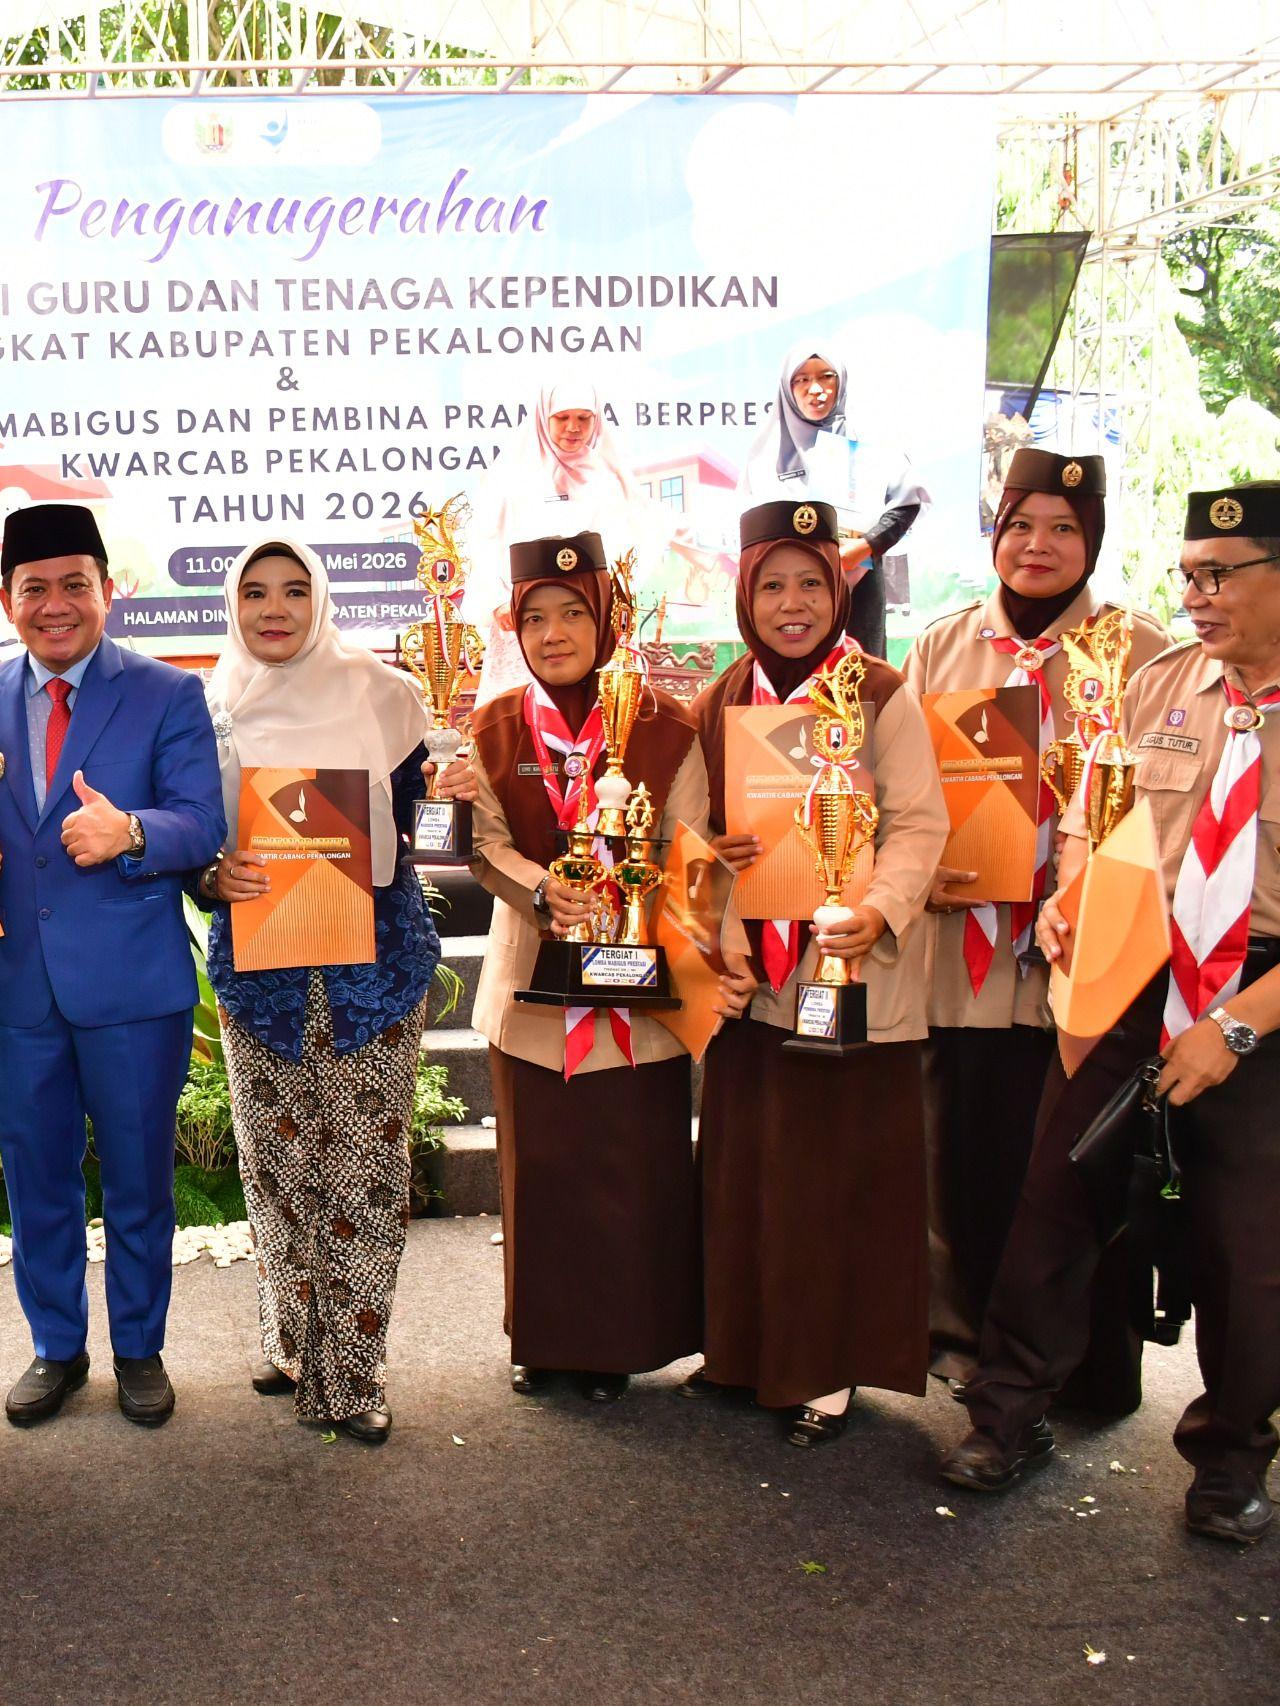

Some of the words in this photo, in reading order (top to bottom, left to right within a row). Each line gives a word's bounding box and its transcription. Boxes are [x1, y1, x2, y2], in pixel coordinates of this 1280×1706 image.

[34, 167, 548, 264] Penganugerahan
[26, 279, 150, 316] GURU
[167, 278, 259, 313] DAN
[274, 276, 455, 312] TENAGA
[468, 275, 779, 309] KEPENDIDIKAN
[109, 328, 350, 360] KABUPATEN
[370, 325, 642, 356] PEKALONGAN
[276, 366, 300, 391] &
[176, 407, 252, 434] DAN
[269, 405, 428, 432] PEMBINA
[444, 402, 620, 430] PRAA
[61, 450, 249, 479] KWARCAB
[168, 493, 305, 524] TAHUN
[324, 490, 429, 521] 2026
[326, 552, 358, 570] Mei
[361, 552, 407, 570] 2026
[124, 609, 199, 625] HALAMAN
[202, 609, 229, 623] DIN
[331, 604, 376, 619] PATEN
[380, 603, 433, 618] PEKALO
[1167, 737, 1194, 750] TUTUR
[280, 852, 306, 860] CABANG
[307, 851, 352, 860] PEKALONGAN
[601, 949, 633, 960] TERGIAT
